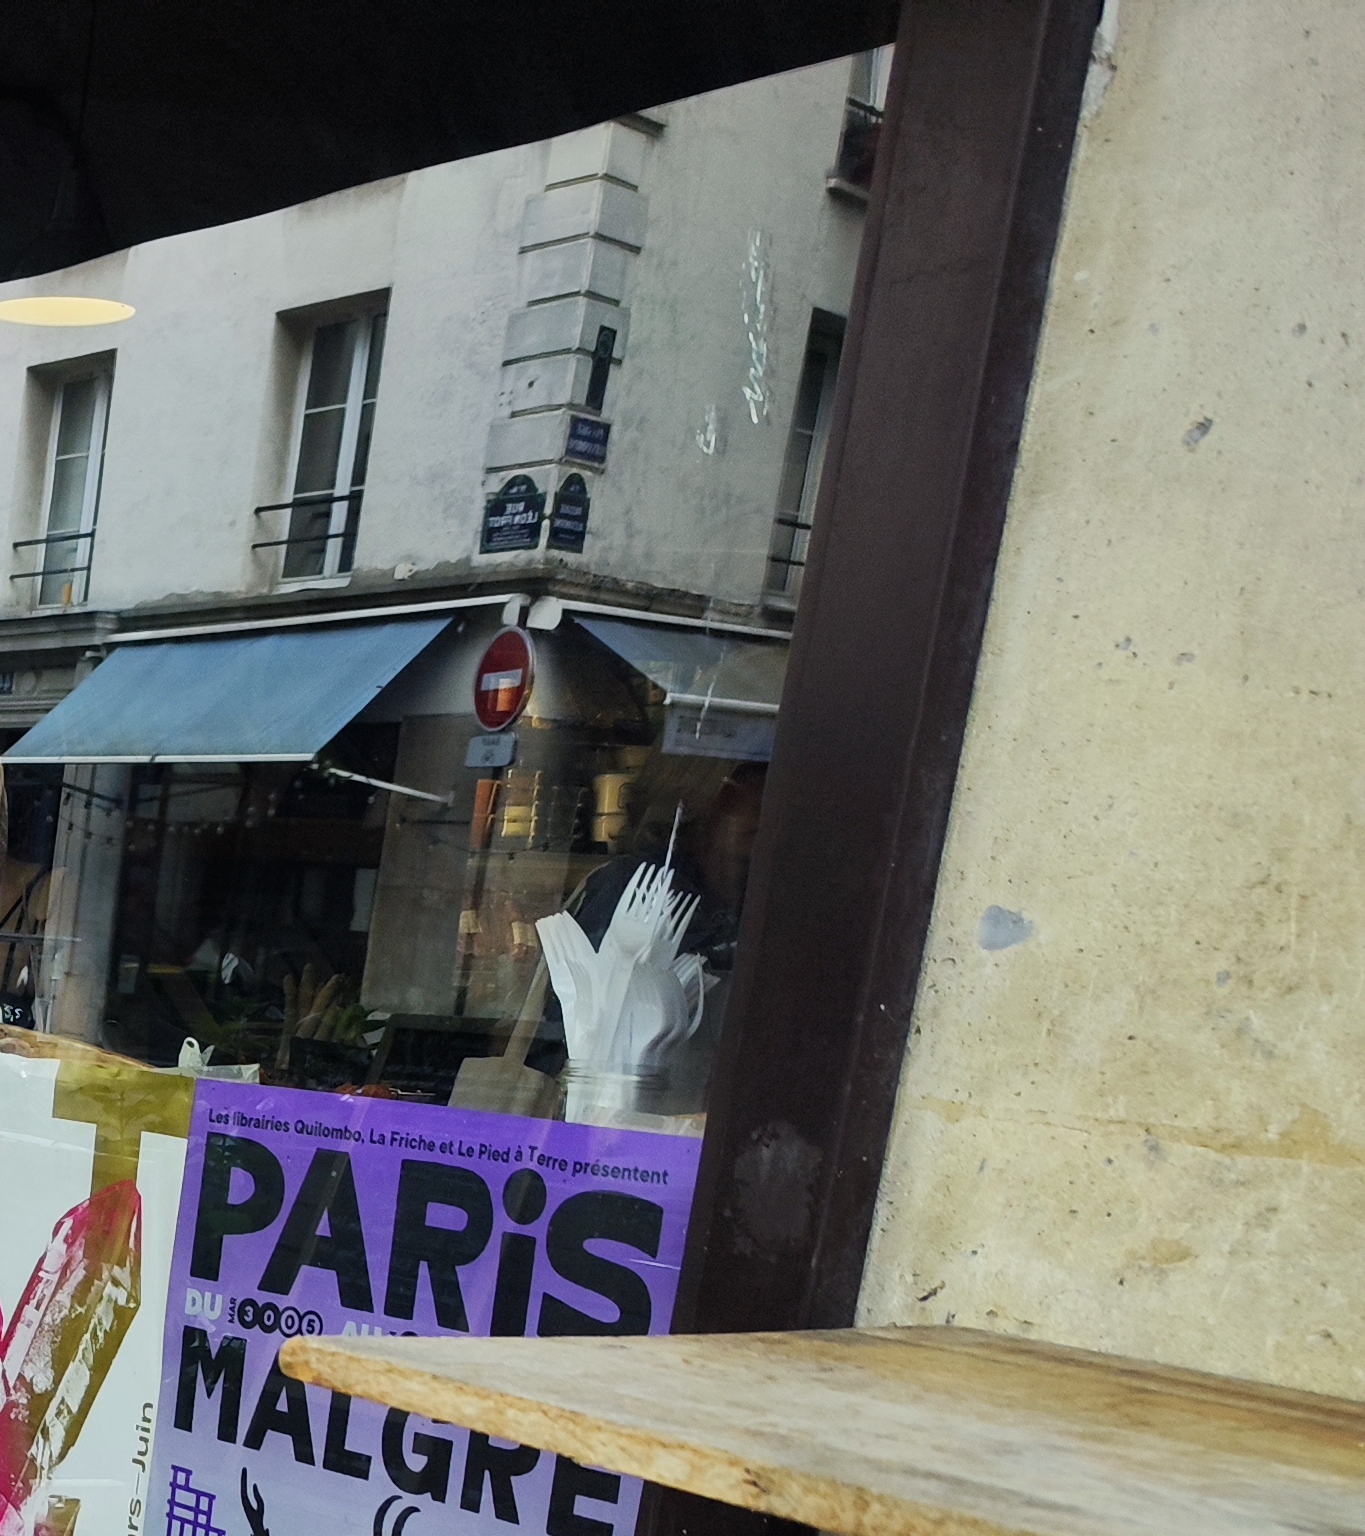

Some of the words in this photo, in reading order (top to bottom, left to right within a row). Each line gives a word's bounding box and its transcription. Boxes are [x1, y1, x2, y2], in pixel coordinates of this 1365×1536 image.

[208, 1108, 230, 1125] Les
[232, 1111, 290, 1133] librairies
[294, 1119, 365, 1145] Quilombo,
[369, 1128, 386, 1145] La
[389, 1131, 436, 1152] Friche
[438, 1139, 455, 1155] et
[457, 1140, 475, 1158] Le
[477, 1143, 511, 1163] Pied
[514, 1144, 523, 1162] à
[528, 1145, 568, 1172] Terre
[572, 1158, 669, 1185] présentent
[184, 1287, 223, 1321] DU
[227, 1296, 238, 1324] MAR
